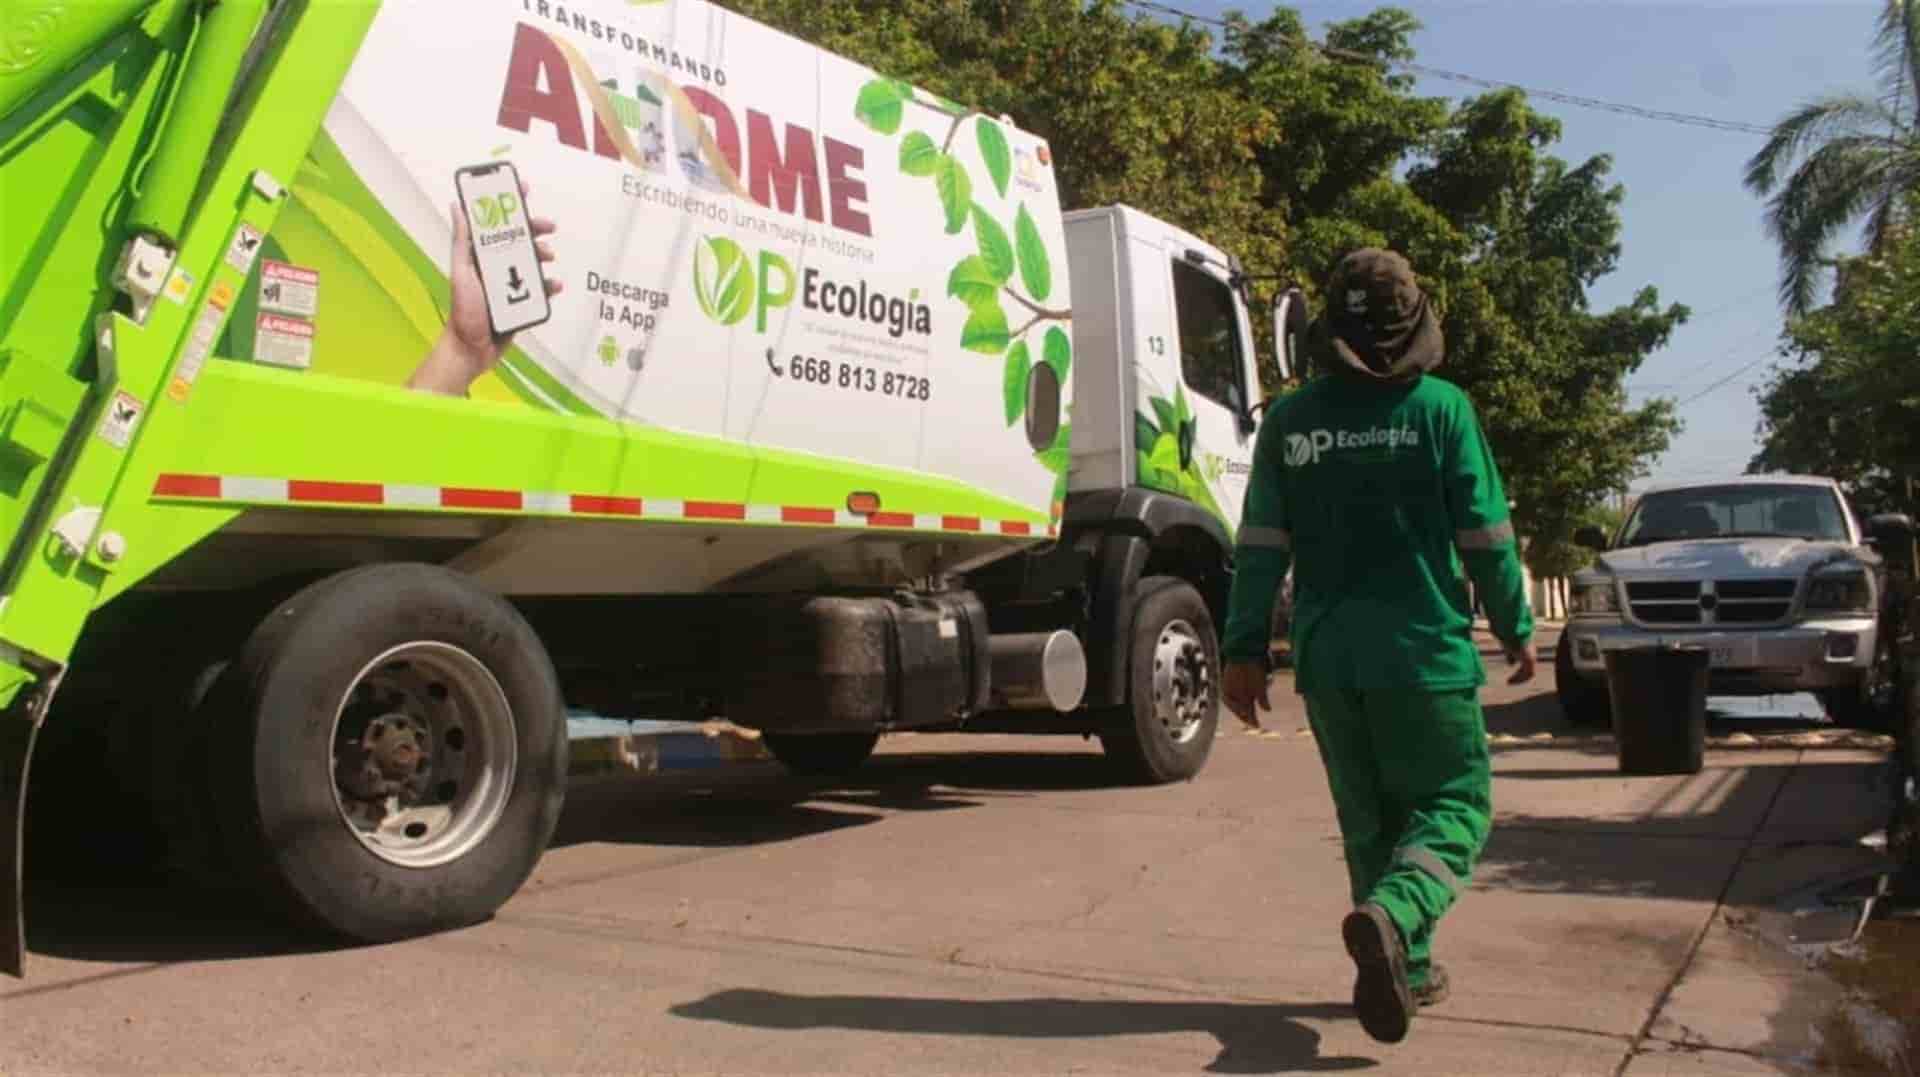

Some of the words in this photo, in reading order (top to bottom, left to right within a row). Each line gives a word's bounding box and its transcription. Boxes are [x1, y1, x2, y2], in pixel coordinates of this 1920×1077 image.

[621, 173, 729, 225] Escribiendo
[586, 270, 669, 310] Descarga
[599, 298, 615, 321] la
[619, 304, 656, 333] App
[1148, 335, 1164, 356] 13
[789, 354, 831, 385] 668
[838, 362, 877, 392] 813
[882, 371, 931, 402] 8728
